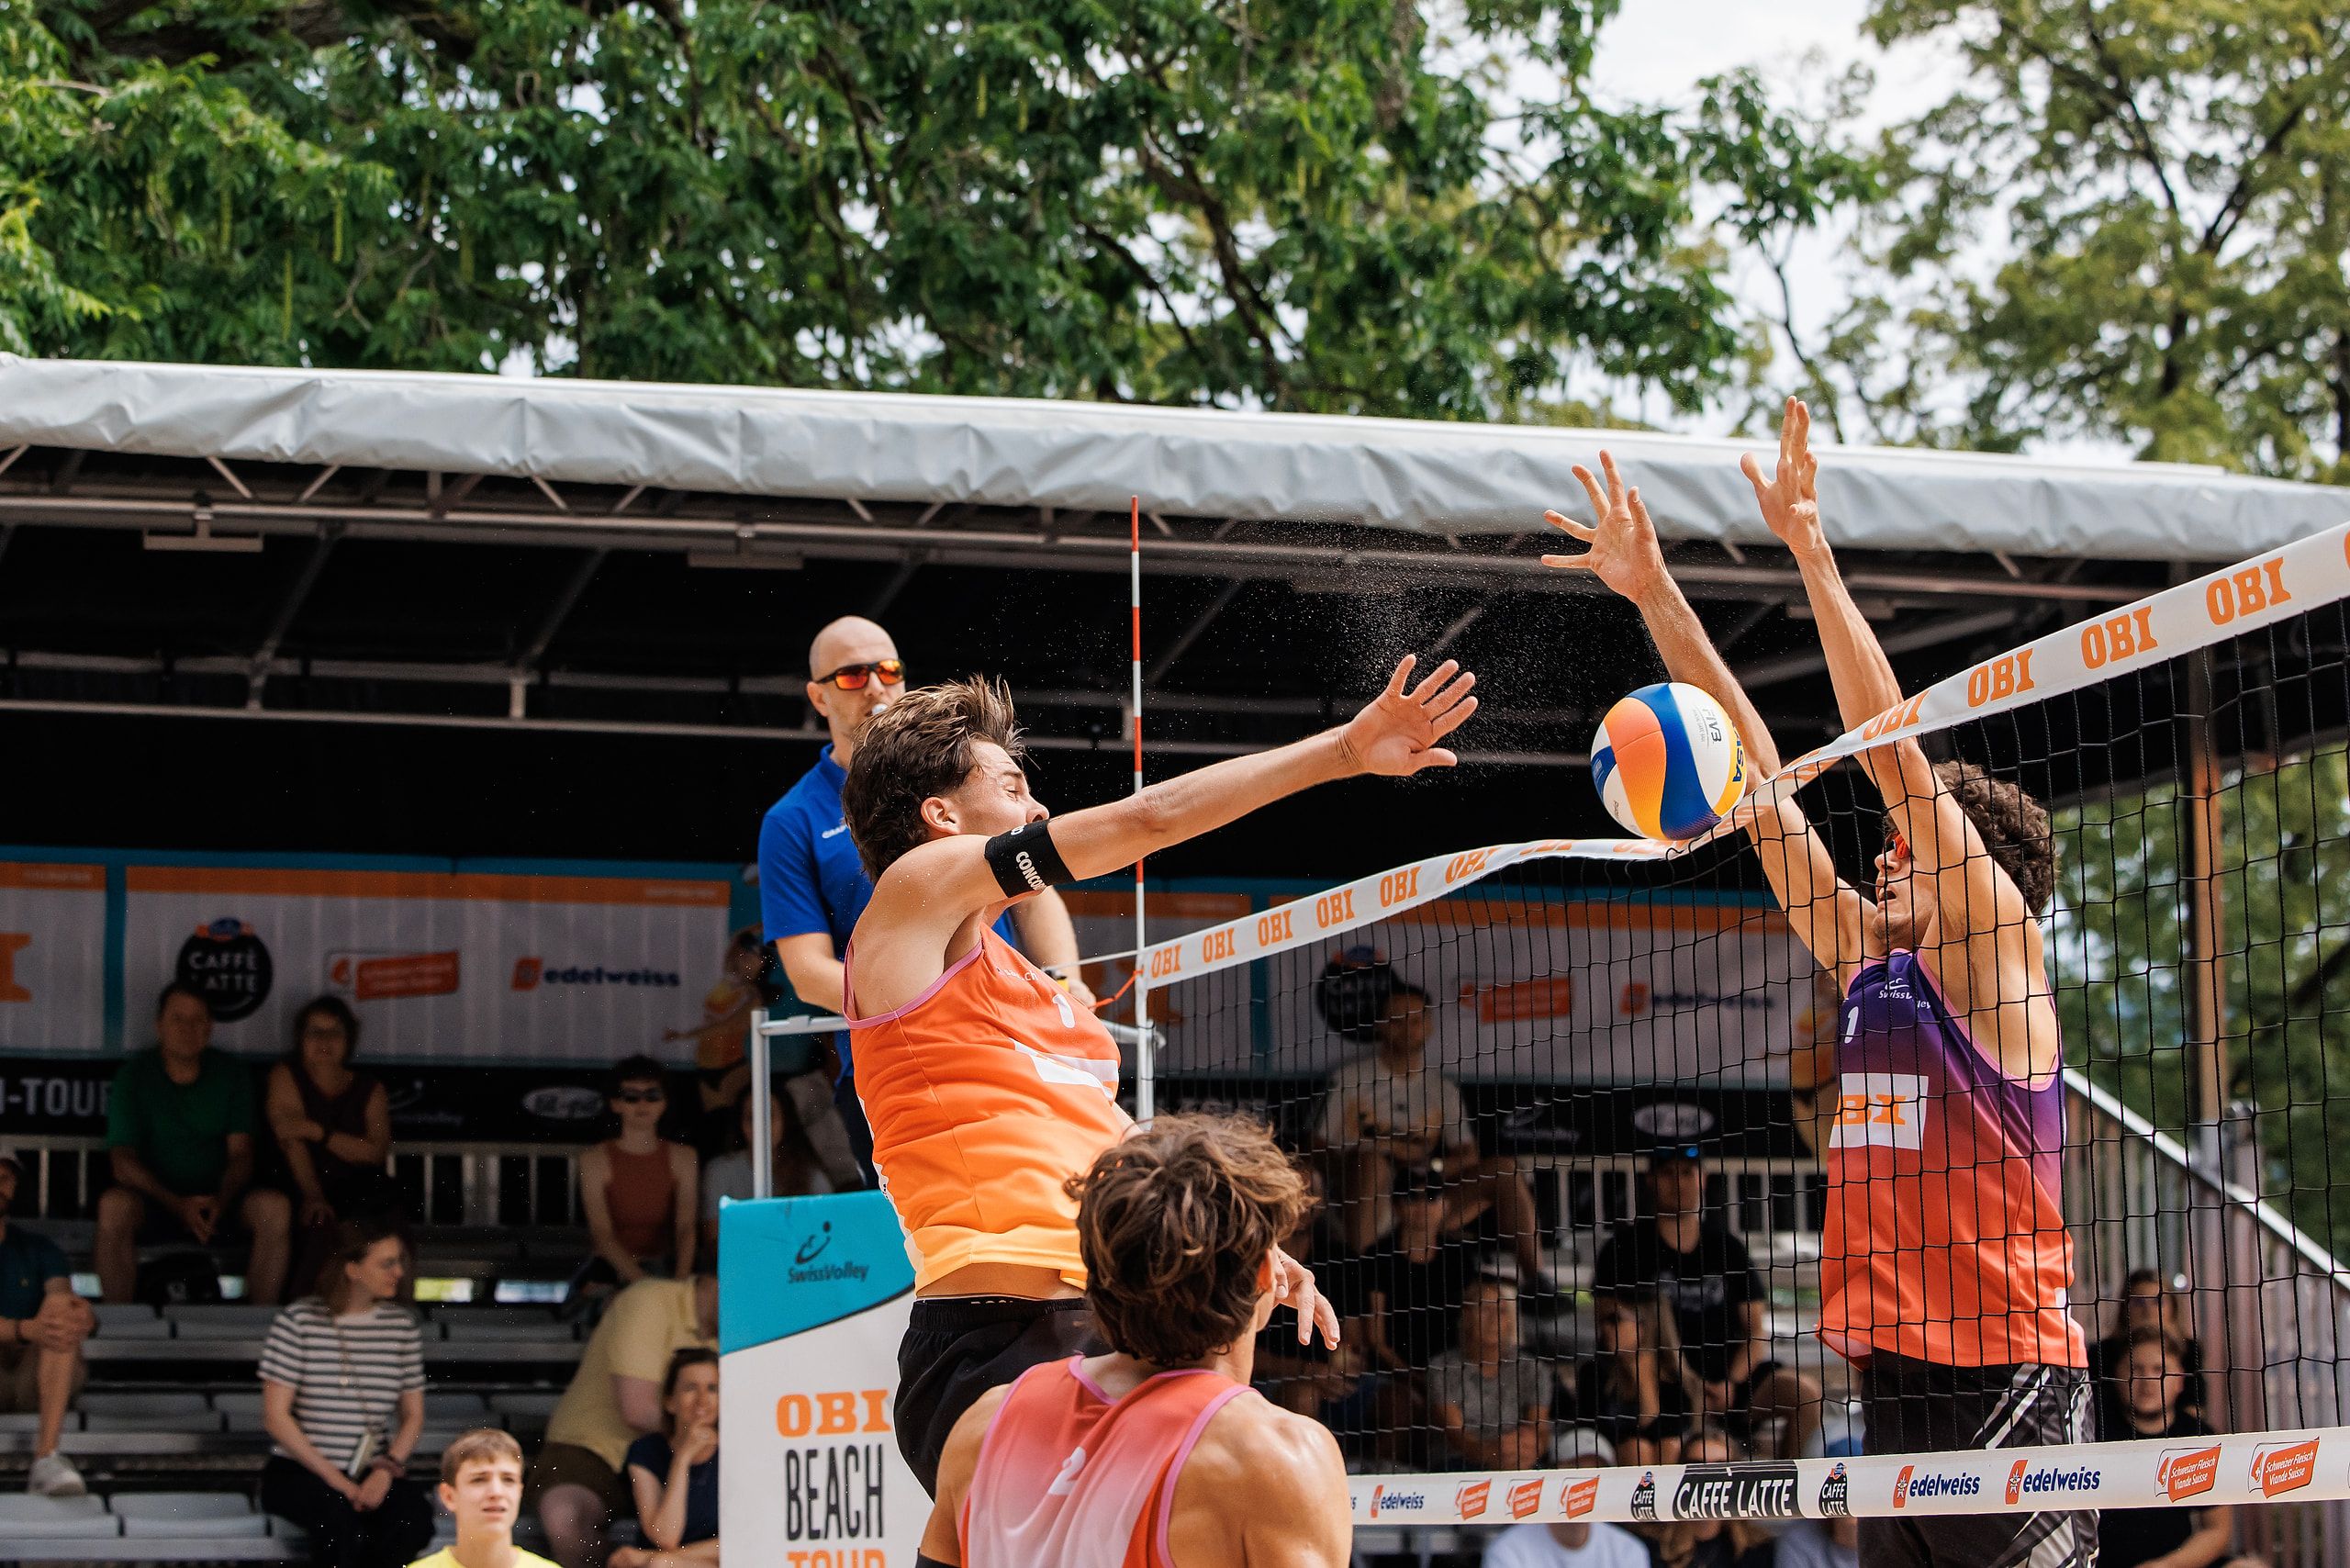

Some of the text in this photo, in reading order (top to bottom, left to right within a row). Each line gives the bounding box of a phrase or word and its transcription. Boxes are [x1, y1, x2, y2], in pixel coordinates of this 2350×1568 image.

[2205, 556, 2292, 628] OBI
[2080, 604, 2158, 671] OBI
[1966, 648, 2035, 709] OBI
[1861, 689, 1930, 742] OBI
[1444, 847, 1501, 886] OBI
[1379, 866, 1422, 908] OBI
[1315, 888, 1356, 929] OBI
[1202, 927, 1236, 964] OBI
[1257, 909, 1293, 947] OBI
[544, 967, 680, 987] edelweiss
[1150, 944, 1182, 980] OBI
[1051, 993, 1077, 1029] 1
[1844, 1005, 1860, 1044] 1
[1833, 1093, 1908, 1126] BI
[777, 1389, 892, 1439] OBI
[1047, 1446, 1087, 1495] 2
[2022, 1466, 2101, 1493] edelweiss
[2170, 1455, 2216, 1479] Schweizer Fleisch
[2265, 1450, 2314, 1473] Schweizer Fleisch
[2269, 1466, 2306, 1486] Viande Suisse
[786, 1443, 884, 1541] BEACH
[1737, 1478, 1795, 1518] LATTE
[1909, 1472, 1981, 1497] edelweiss
[2174, 1472, 2209, 1490] Viande Suisse
[1381, 1492, 1424, 1509] edelweiss
[1822, 1500, 1847, 1517] LATTE
